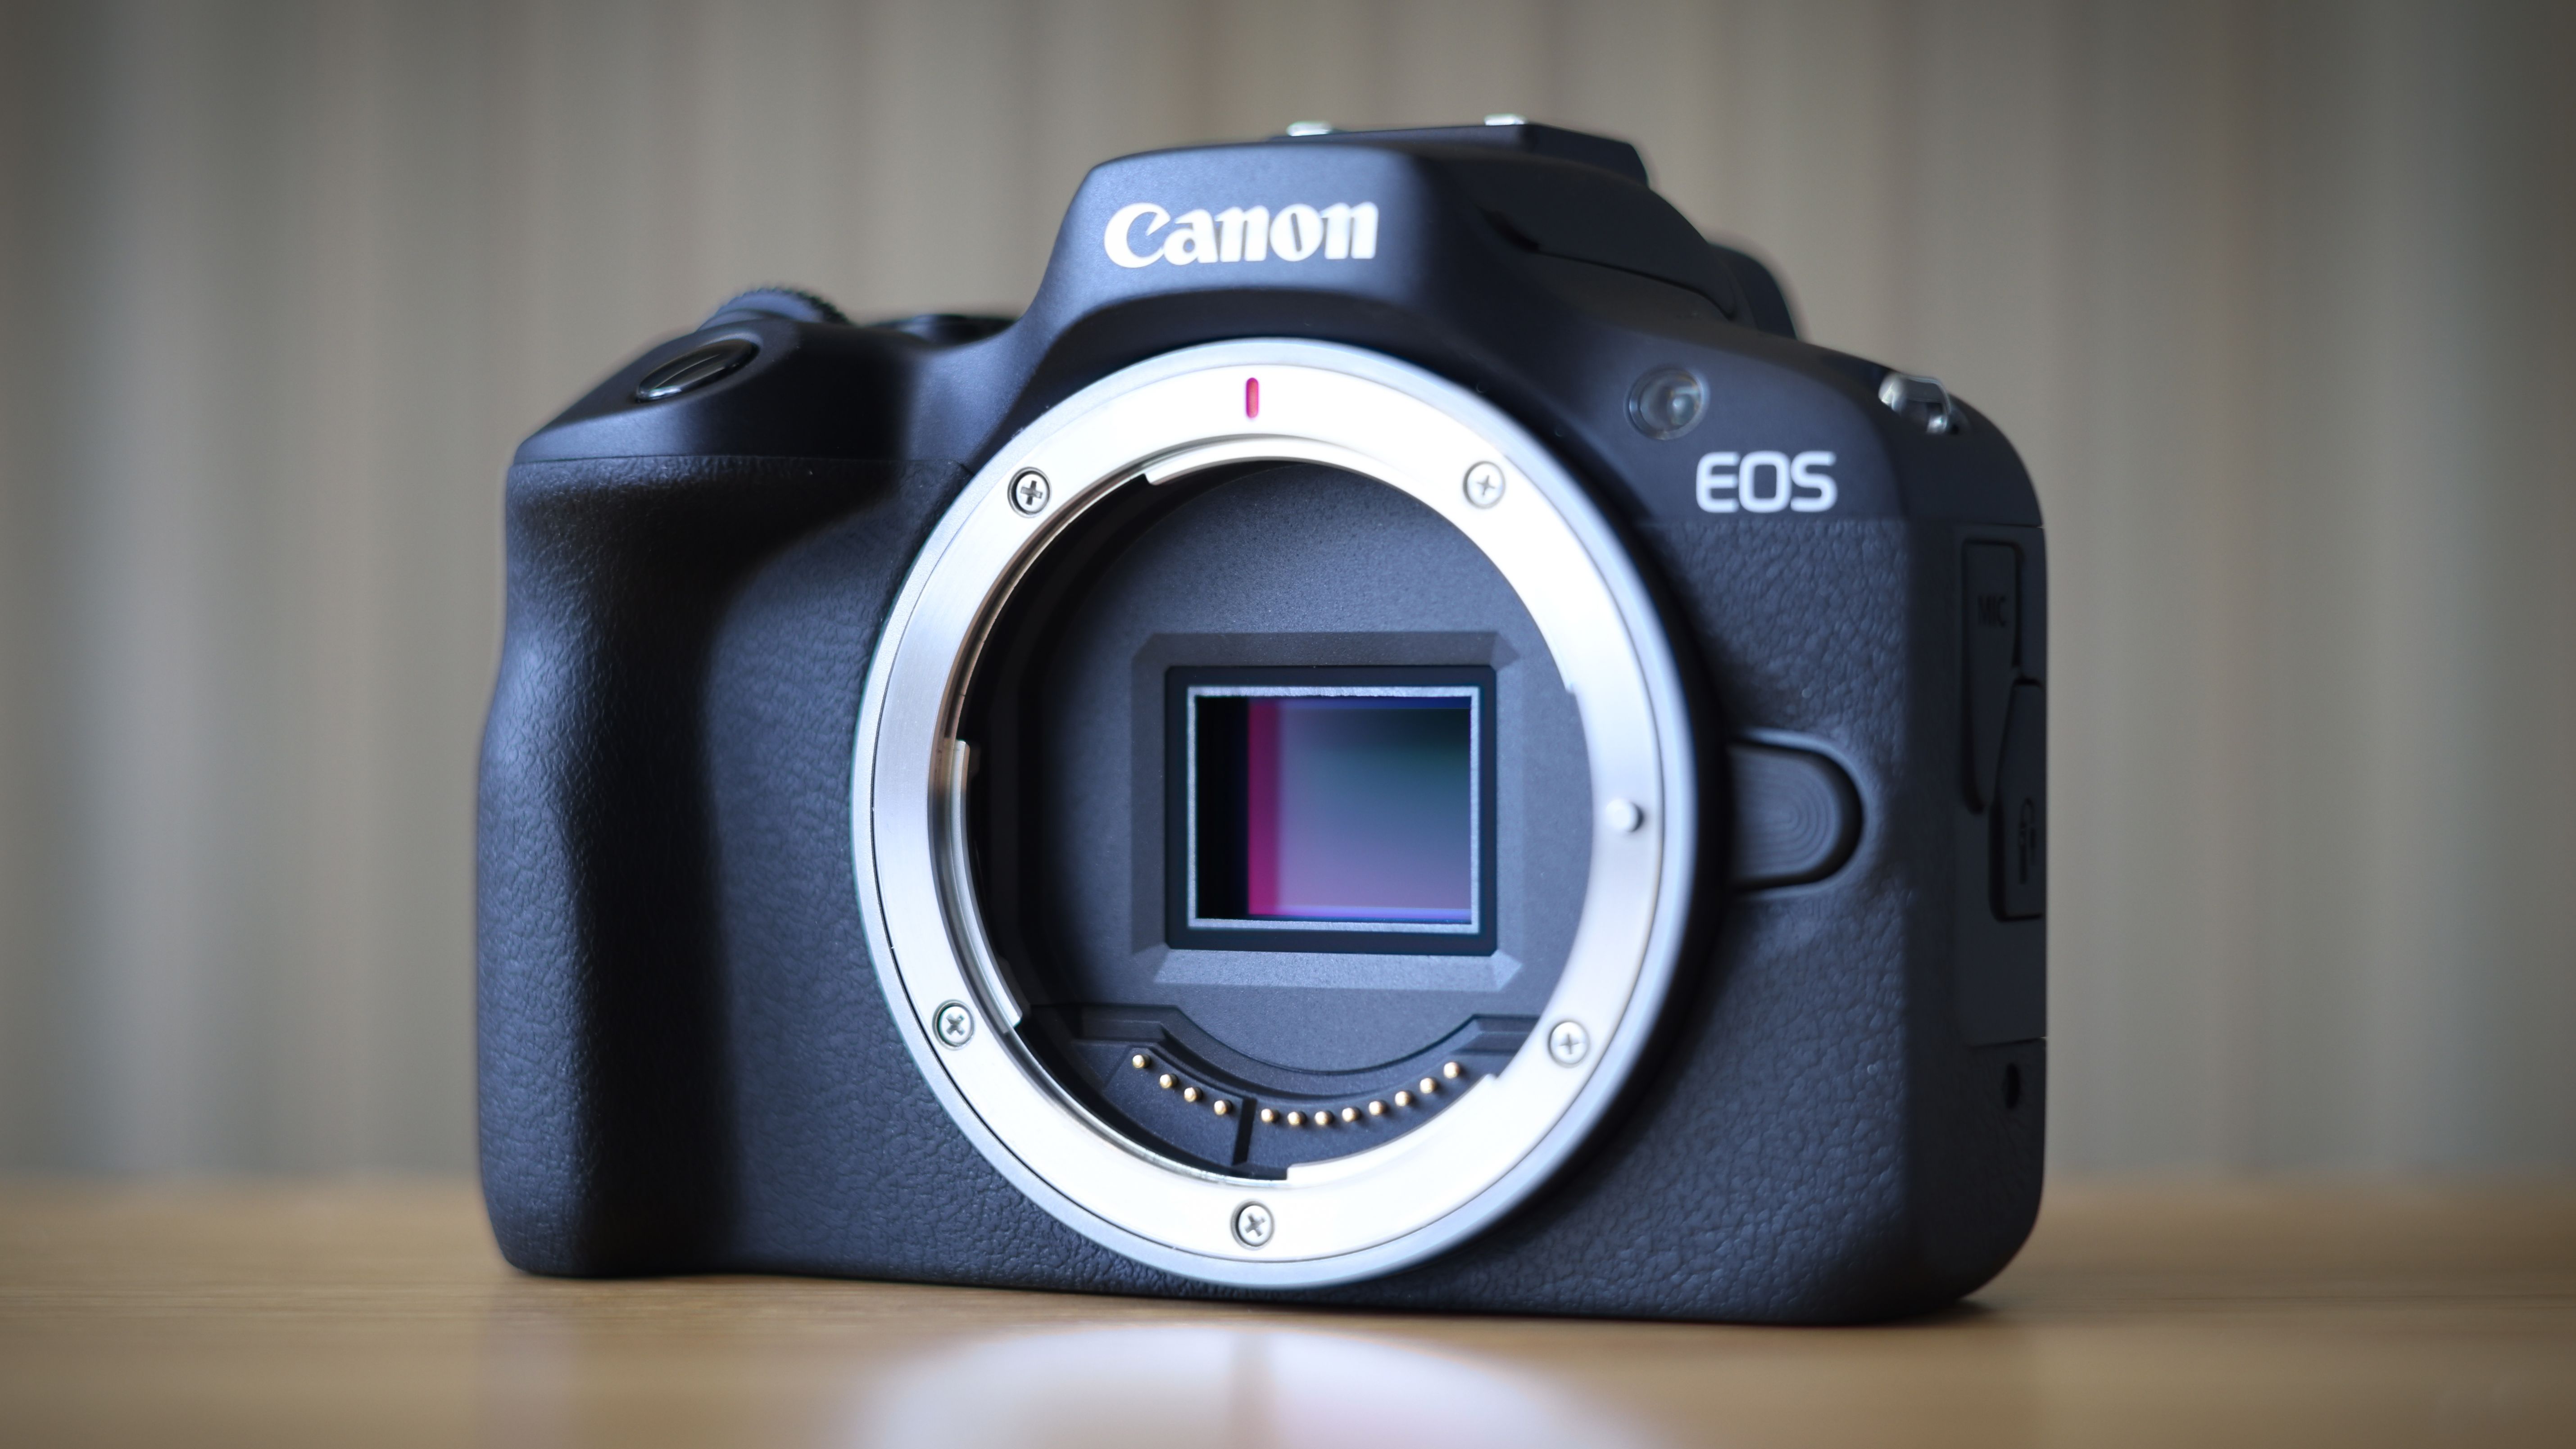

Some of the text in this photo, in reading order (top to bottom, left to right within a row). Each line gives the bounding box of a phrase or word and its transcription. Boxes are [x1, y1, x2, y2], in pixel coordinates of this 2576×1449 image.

[1104, 202, 1379, 268] Canon
[1696, 451, 1837, 512] EOS
[1977, 594, 2007, 627] MIC
